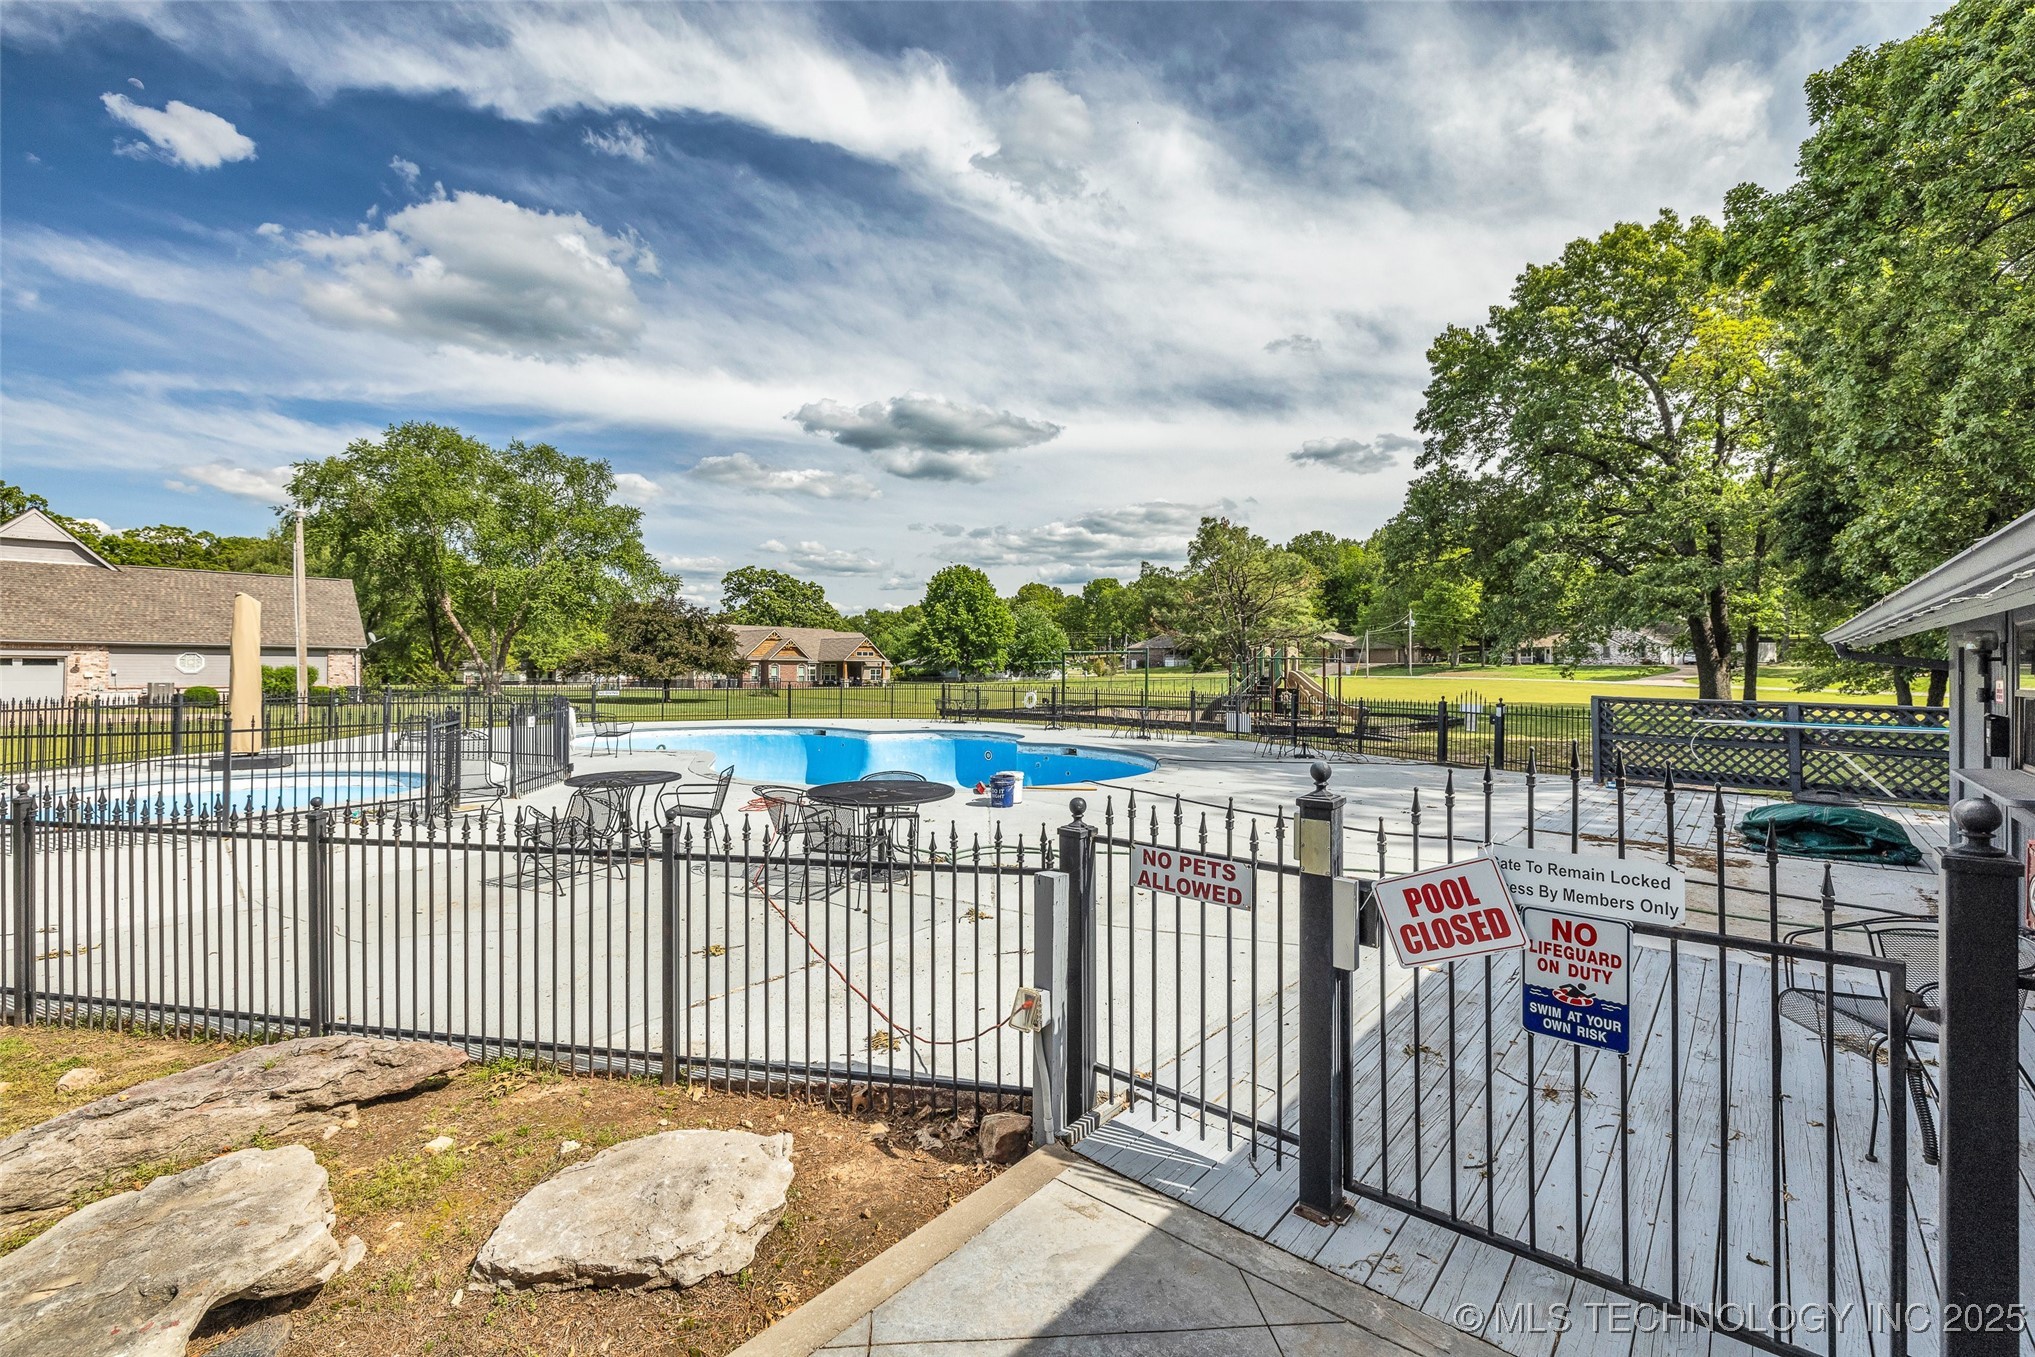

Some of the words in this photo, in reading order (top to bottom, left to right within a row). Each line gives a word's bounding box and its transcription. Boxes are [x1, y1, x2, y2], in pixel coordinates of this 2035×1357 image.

[1143, 848, 1172, 869] NO
[1180, 855, 1236, 882] PETS
[1495, 856, 1521, 871] ate
[1526, 860, 1543, 874] To
[1548, 863, 1605, 882] Remain
[1611, 870, 1671, 890] Locked
[1138, 870, 1242, 905] ALLOWED
[1402, 876, 1481, 918] POOL
[1506, 882, 1534, 896] ess
[1539, 885, 1558, 902] By
[1563, 888, 1635, 910] Members
[1640, 899, 1679, 919] Only
[1400, 908, 1512, 954] CLOSED
[1552, 918, 1597, 947] NO
[1529, 939, 1622, 969] LIFEGUARD
[1537, 958, 1559, 974] ON
[1568, 963, 1613, 984] DUTY
[1529, 1002, 1562, 1018] SWIM
[1567, 1011, 1582, 1023] AT
[1586, 1015, 1622, 1033] YOUR
[1543, 1018, 1571, 1034] OWN
[1577, 1026, 1607, 1043] RISK
